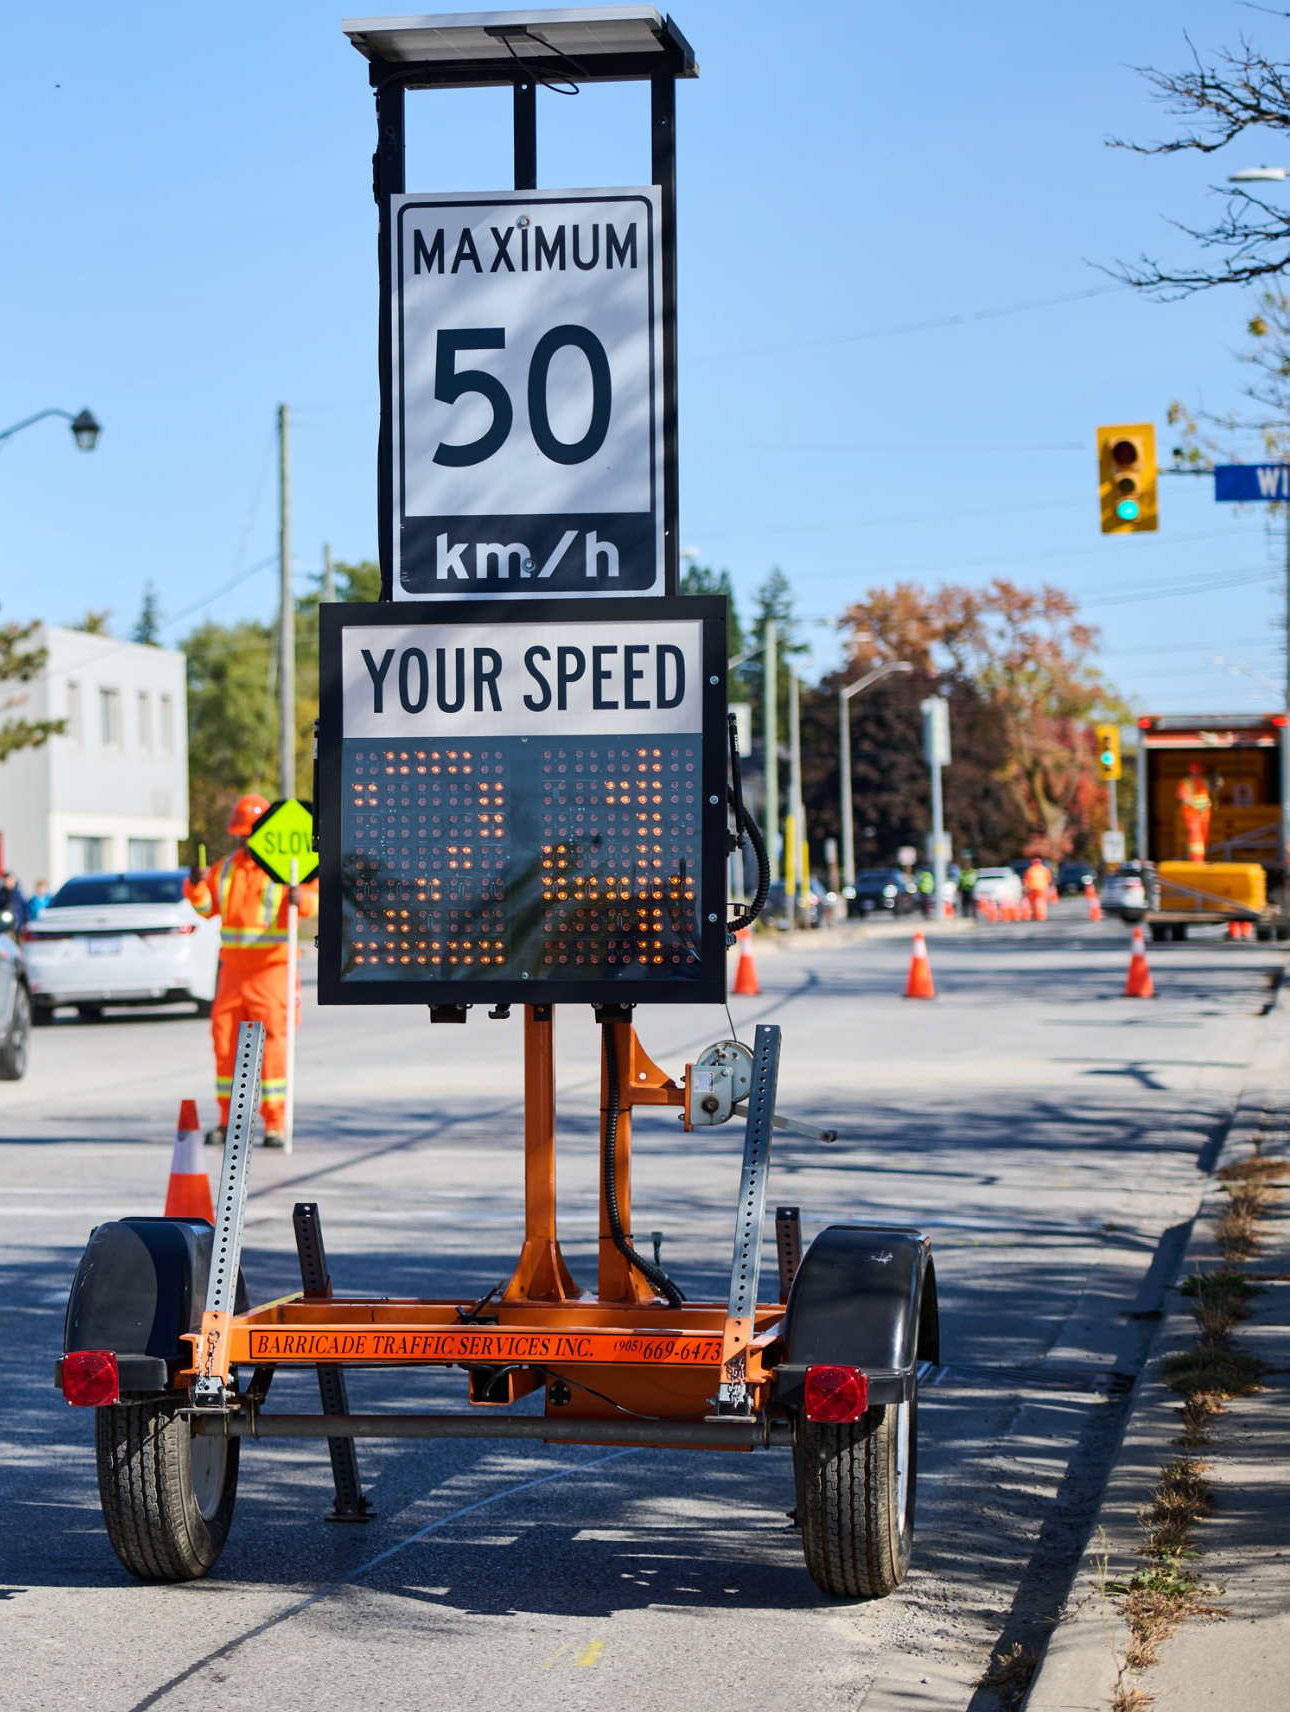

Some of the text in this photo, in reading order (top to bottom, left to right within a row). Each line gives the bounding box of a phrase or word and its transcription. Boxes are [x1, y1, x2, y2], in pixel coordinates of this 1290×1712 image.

[413, 222, 638, 276] MAXIMUM
[432, 324, 612, 468] 50
[436, 530, 620, 580] km/h
[360, 644, 686, 715] YOUR SPEED
[257, 1335, 367, 1354] BARRICADE
[372, 1336, 453, 1355] TRAFFIC
[458, 1336, 551, 1356] SERVICES
[555, 1338, 594, 1357] INC.
